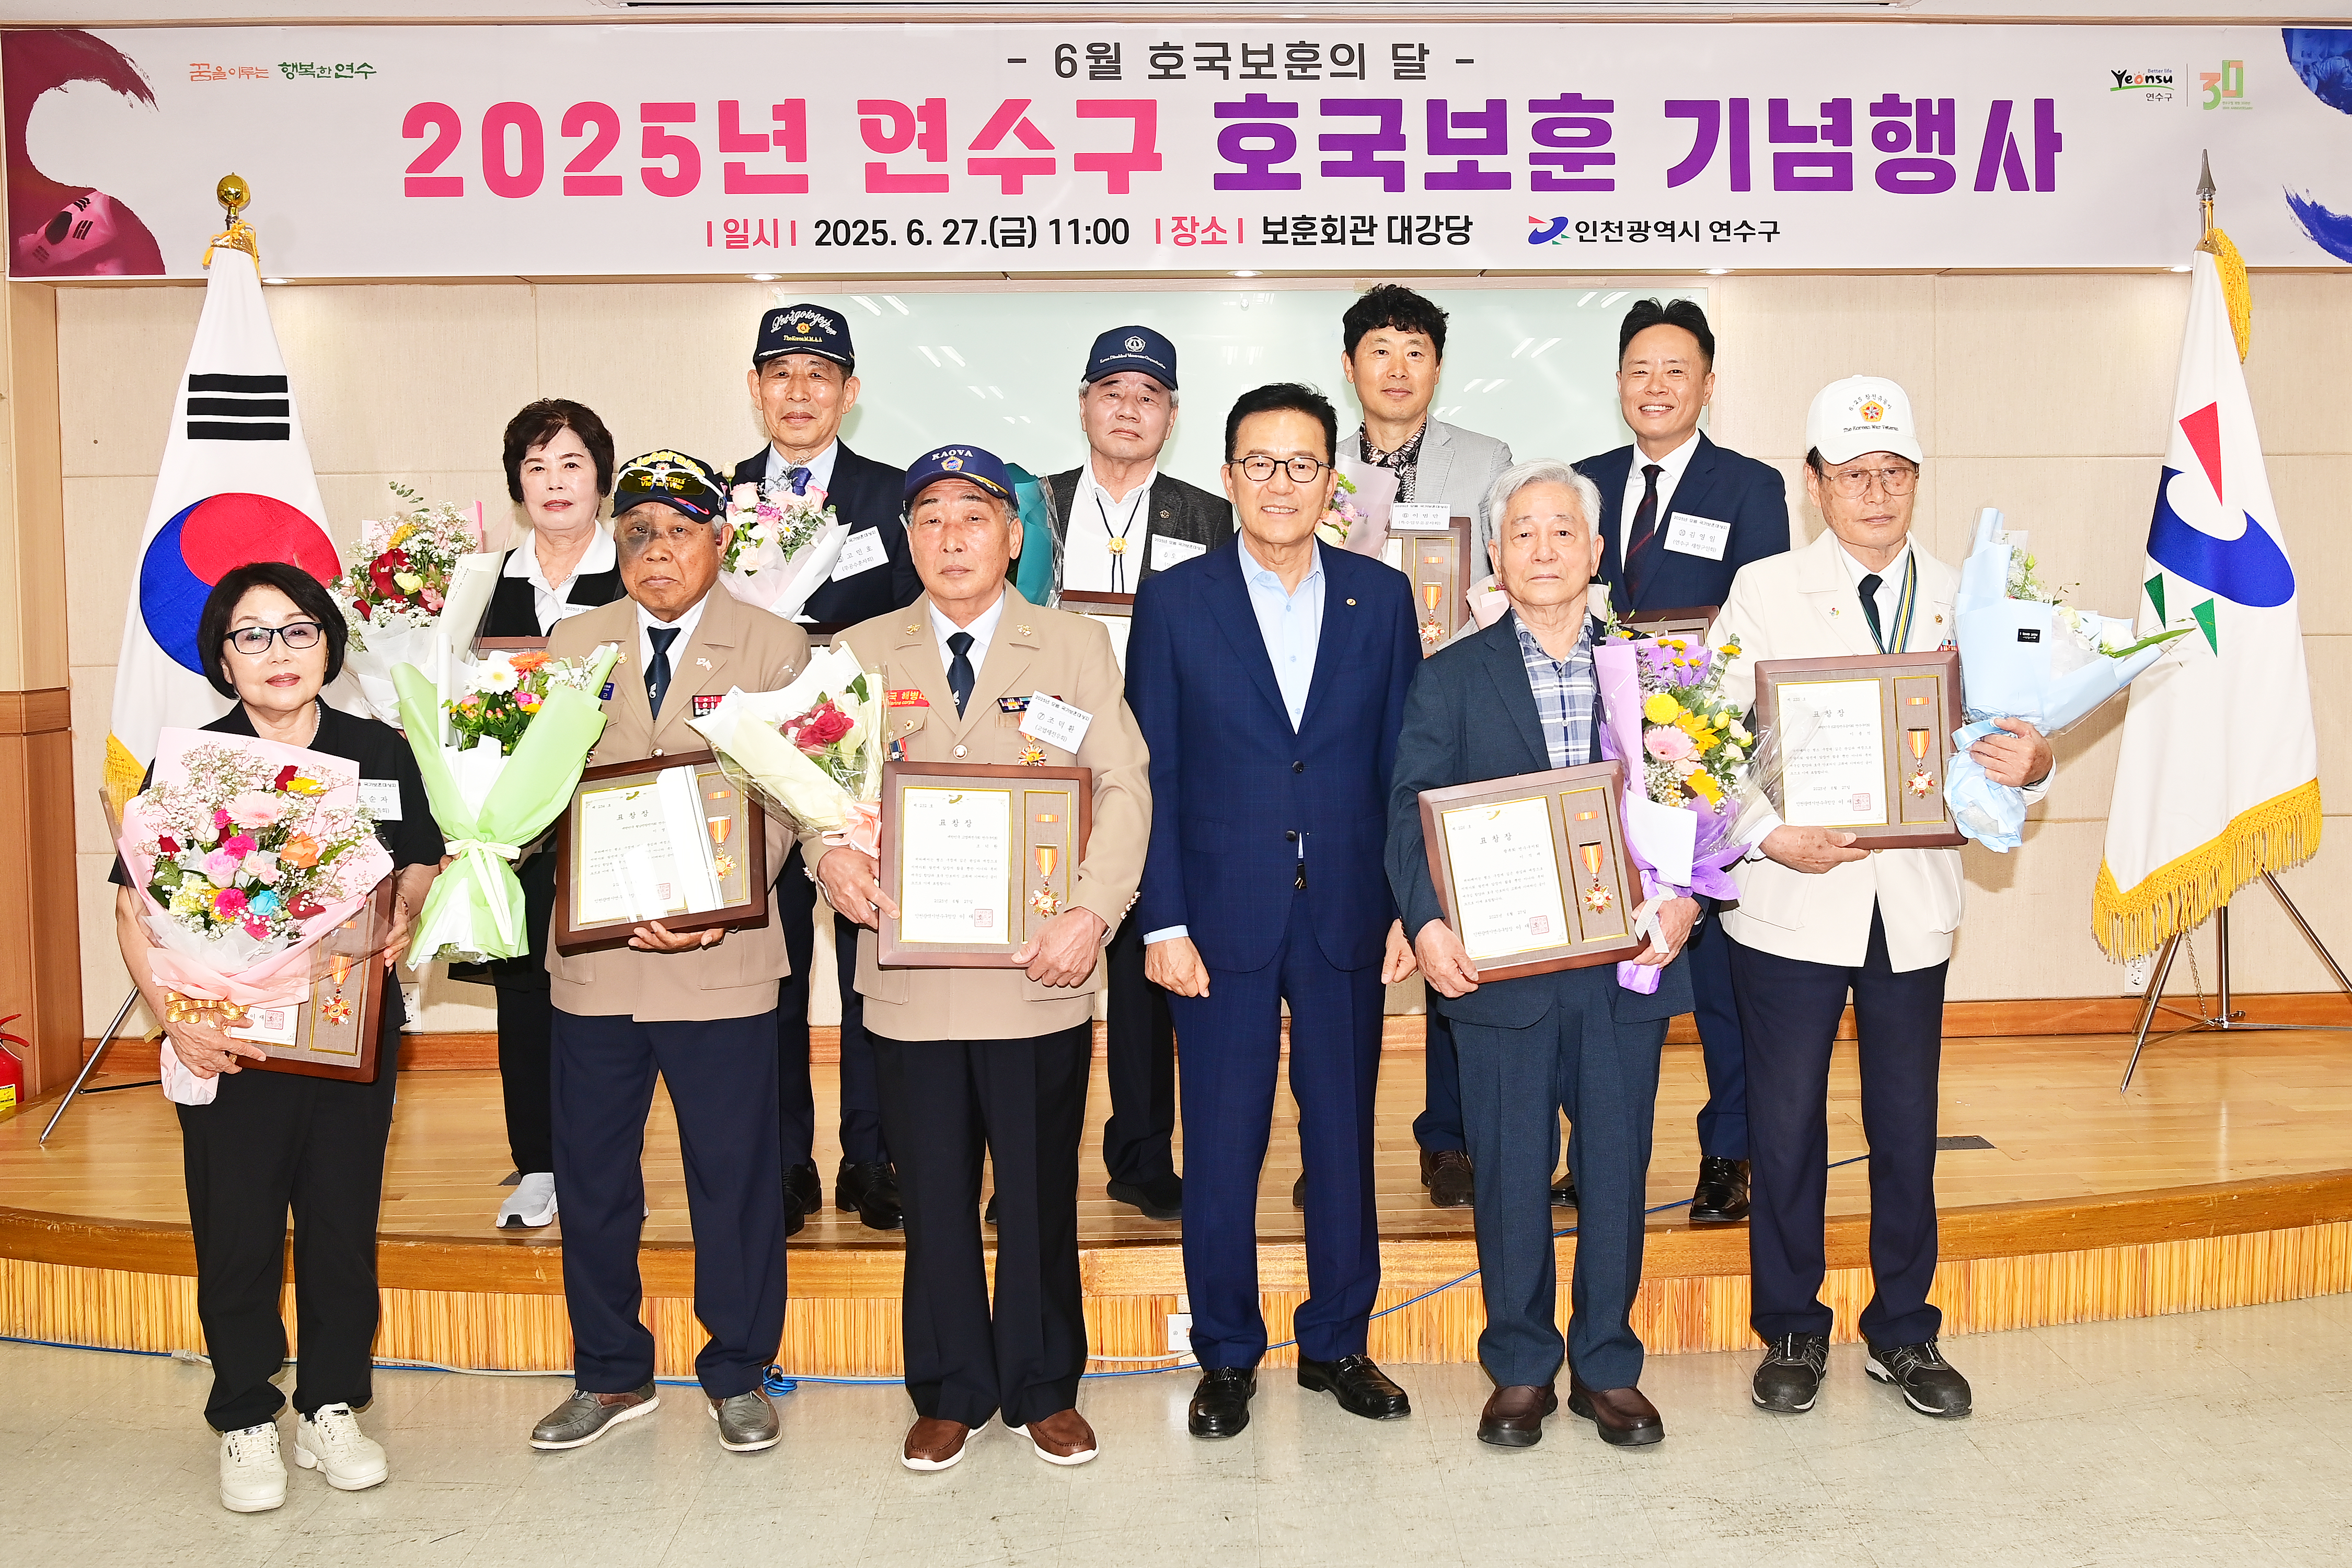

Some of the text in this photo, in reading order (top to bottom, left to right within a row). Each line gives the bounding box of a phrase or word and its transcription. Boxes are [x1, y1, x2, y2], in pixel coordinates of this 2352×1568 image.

[190, 62, 377, 82] 꿈을 이루는 행복한 연수
[1055, 41, 1431, 81] 6월 호국보훈의 달
[2111, 69, 2173, 89] Yeonsu
[2146, 93, 2173, 102] 연수구
[402, 93, 2063, 199] 2025년 연수구 호국보훈 기념행사
[723, 215, 1474, 249] 일시 2025. 6. 27.(금) 11:00 장소 보훈회관 대강당
[1575, 221, 1781, 244] 인천광역시 연수구
[628, 451, 706, 477] Veterans
[931, 449, 974, 461] KAOVA
